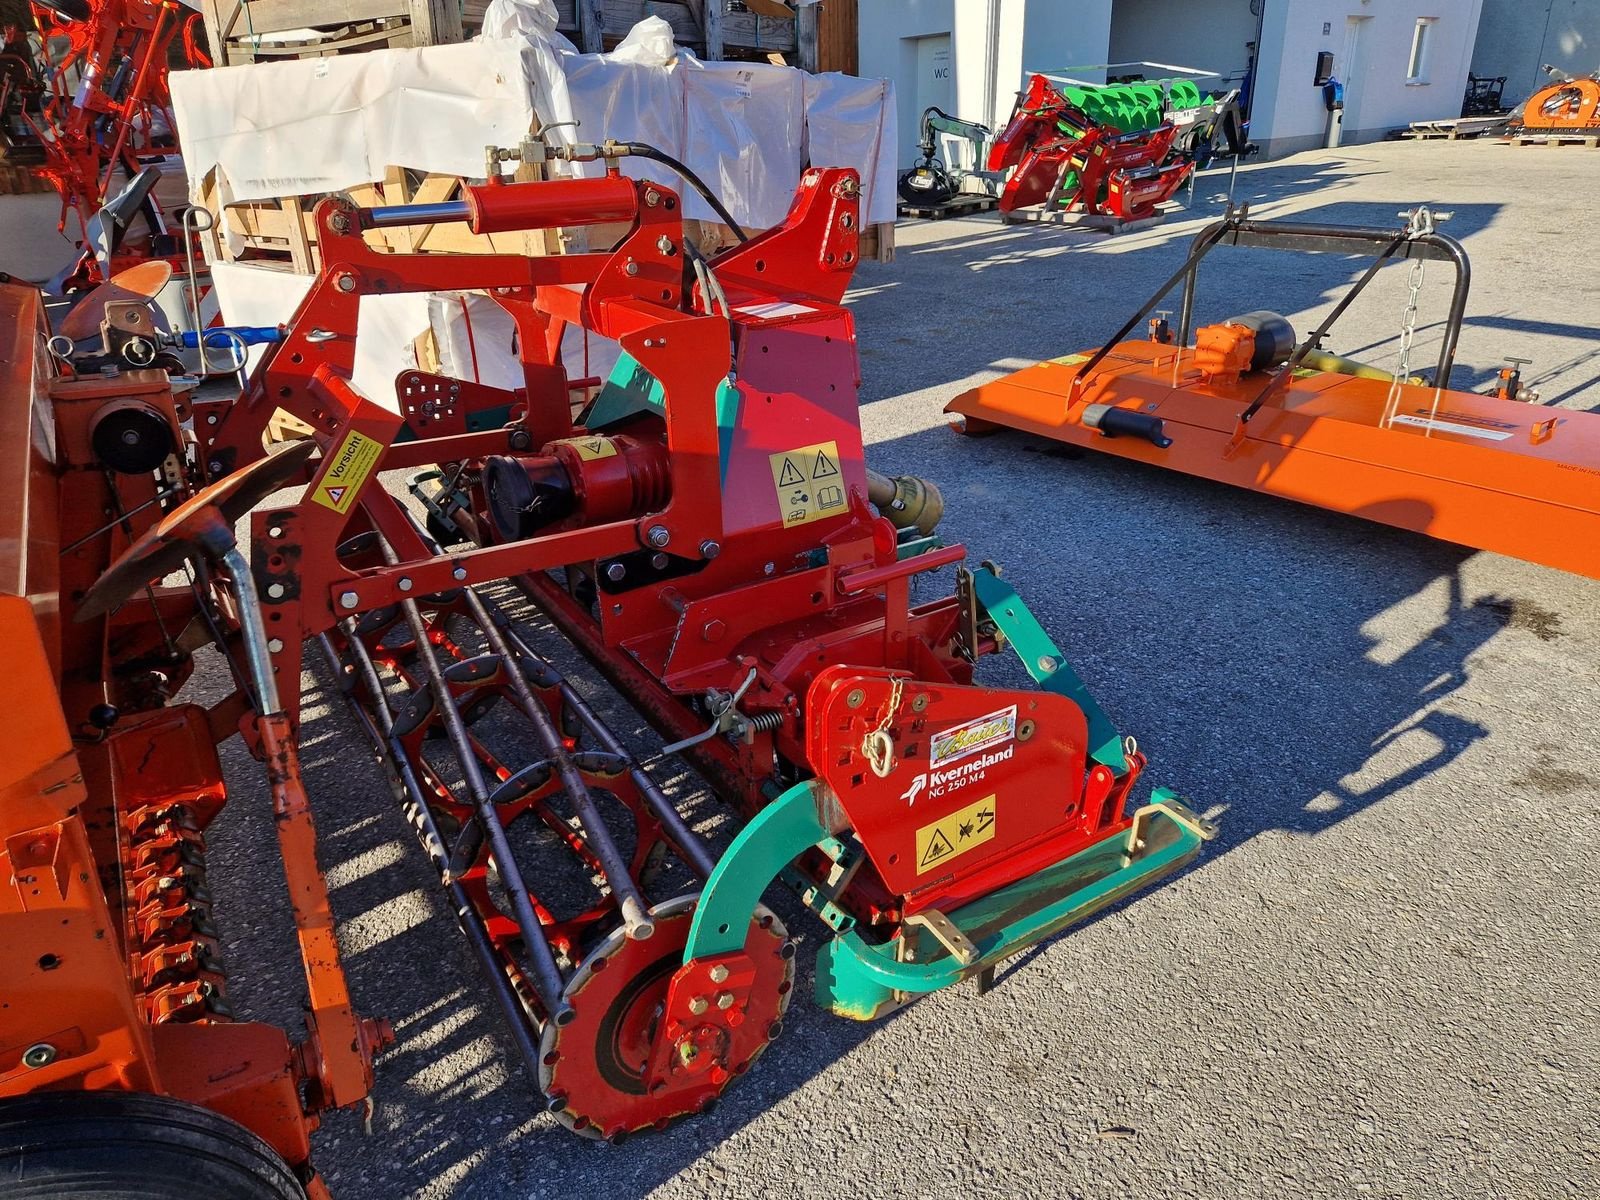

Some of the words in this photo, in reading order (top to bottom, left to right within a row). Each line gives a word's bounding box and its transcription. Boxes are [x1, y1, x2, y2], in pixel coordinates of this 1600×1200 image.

[934, 67, 949, 79] WC
[330, 436, 362, 478] Vorsicht
[1557, 463, 1577, 471] MADE
[930, 744, 1014, 788] Kverneland
[929, 786, 945, 800] NG
[948, 778, 966, 792] 250
[969, 771, 986, 785] M4
